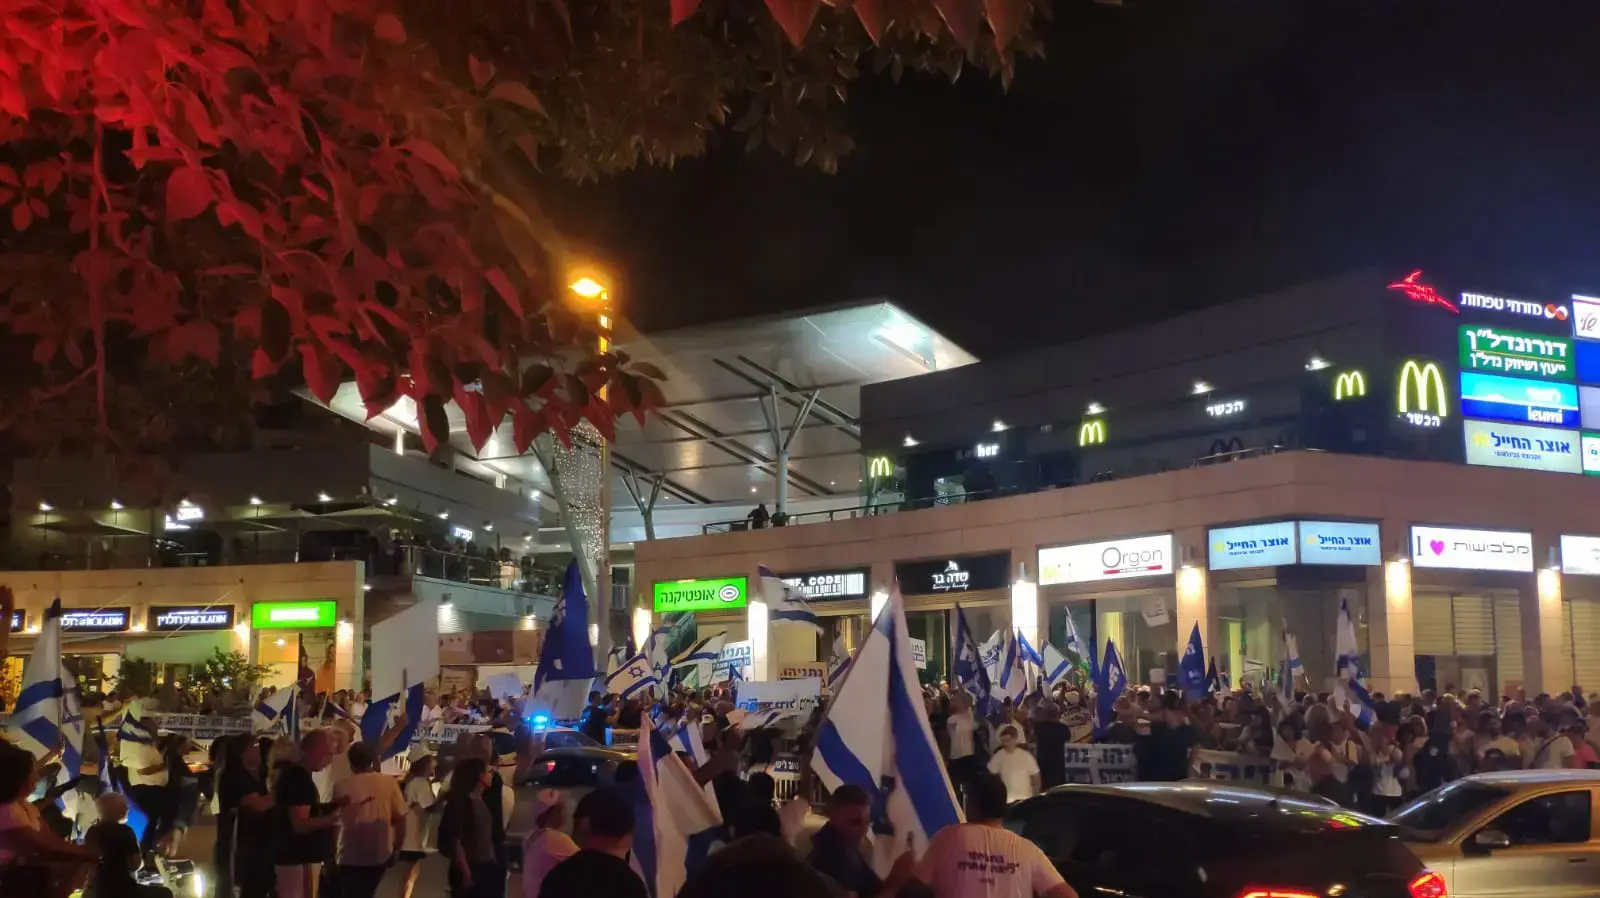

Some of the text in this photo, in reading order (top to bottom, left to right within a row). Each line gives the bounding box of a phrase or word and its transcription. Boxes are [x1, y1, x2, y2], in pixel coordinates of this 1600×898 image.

[1460, 292, 1543, 316] מזרחי טפחות
[1206, 400, 1244, 417] הכשר
[1527, 405, 1563, 424] leumi
[1406, 411, 1441, 427] הכשר
[1490, 431, 1571, 454] אוצר החייל
[1226, 536, 1289, 550] אוצר החייל
[1317, 534, 1372, 546] אוצר החייל
[1416, 535, 1530, 556] I מלבישות
[1101, 547, 1163, 568] Orgon
[808, 575, 842, 586] CODE
[931, 572, 969, 584] שדה בר
[660, 588, 715, 604] אופטיקנה
[719, 646, 751, 659] נתני
